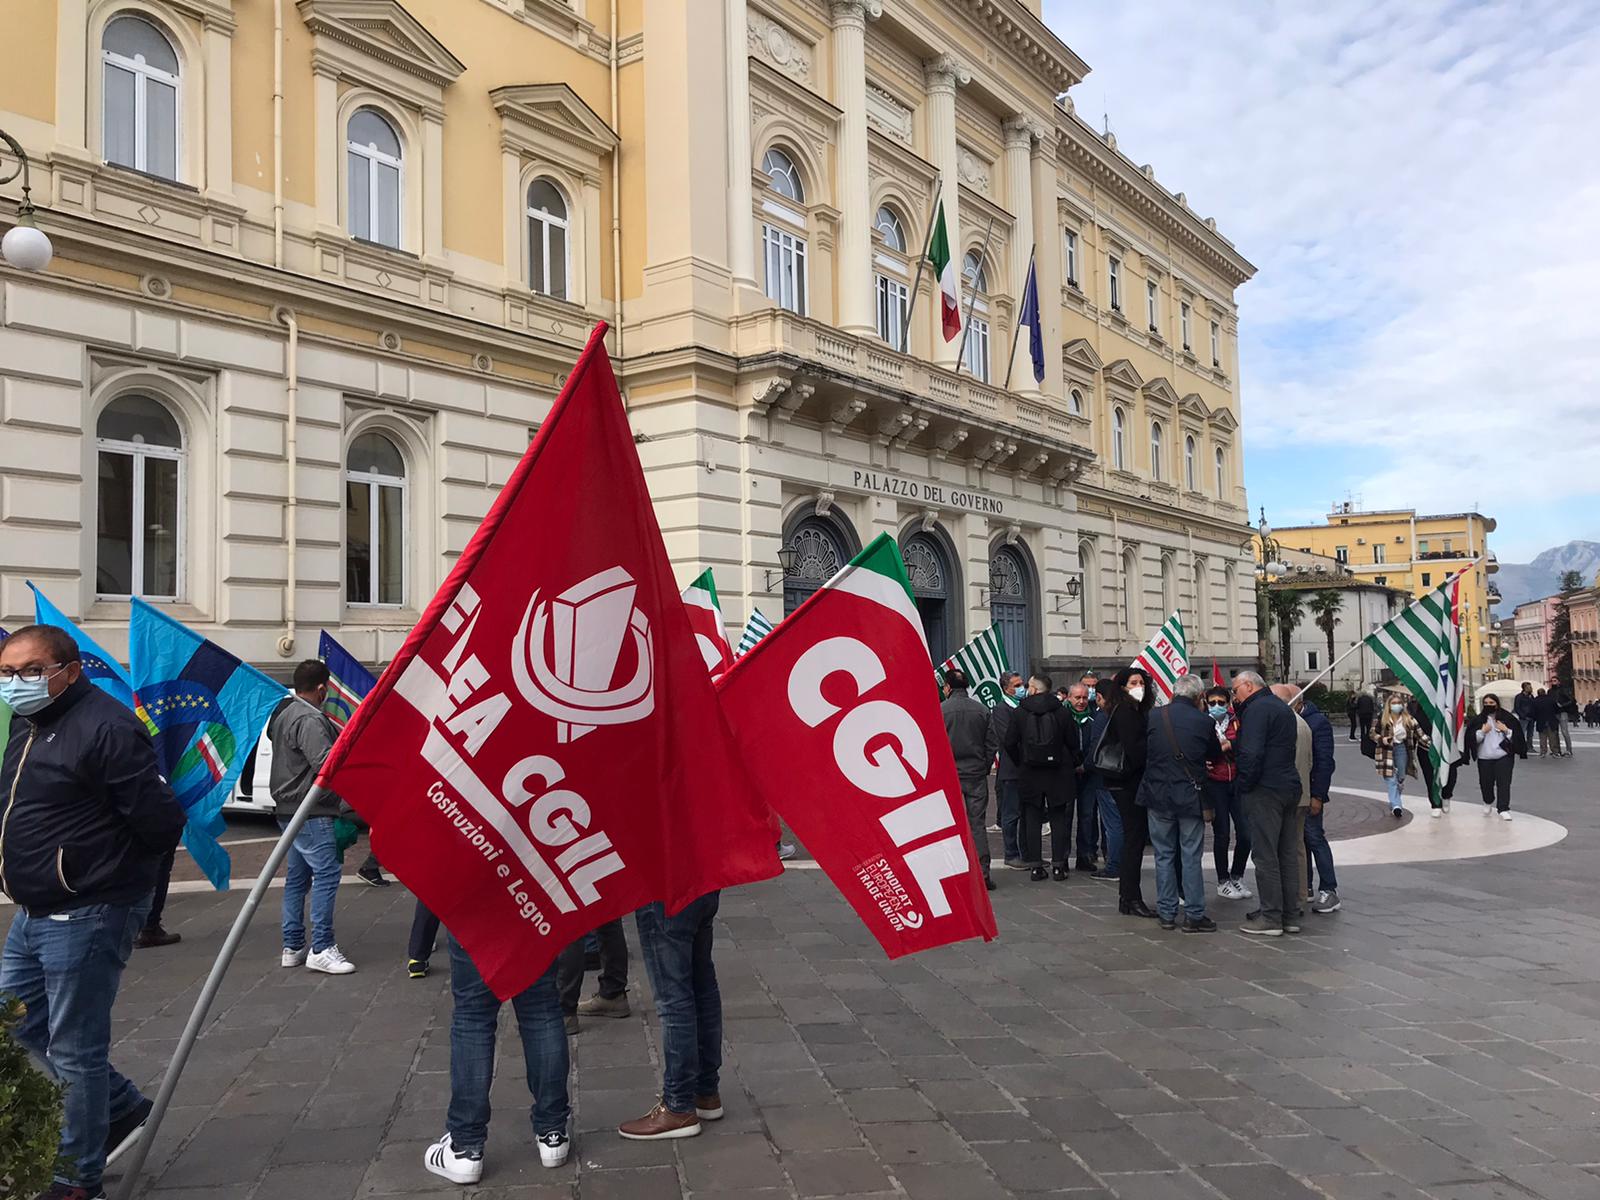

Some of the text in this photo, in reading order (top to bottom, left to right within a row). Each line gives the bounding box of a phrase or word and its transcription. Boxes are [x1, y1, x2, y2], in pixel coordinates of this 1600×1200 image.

[854, 471, 1003, 514] PALAZZO DEL GOVERNO
[1156, 638, 1188, 676] FILCA
[981, 686, 998, 714] CIS
[787, 636, 970, 918] CGIL
[427, 781, 551, 936] Costruzioni e Legno
[502, 754, 626, 907] CGIL
[856, 868, 883, 900] TRADE
[878, 898, 905, 932] UNION
[876, 858, 913, 907] SYNDICAT
